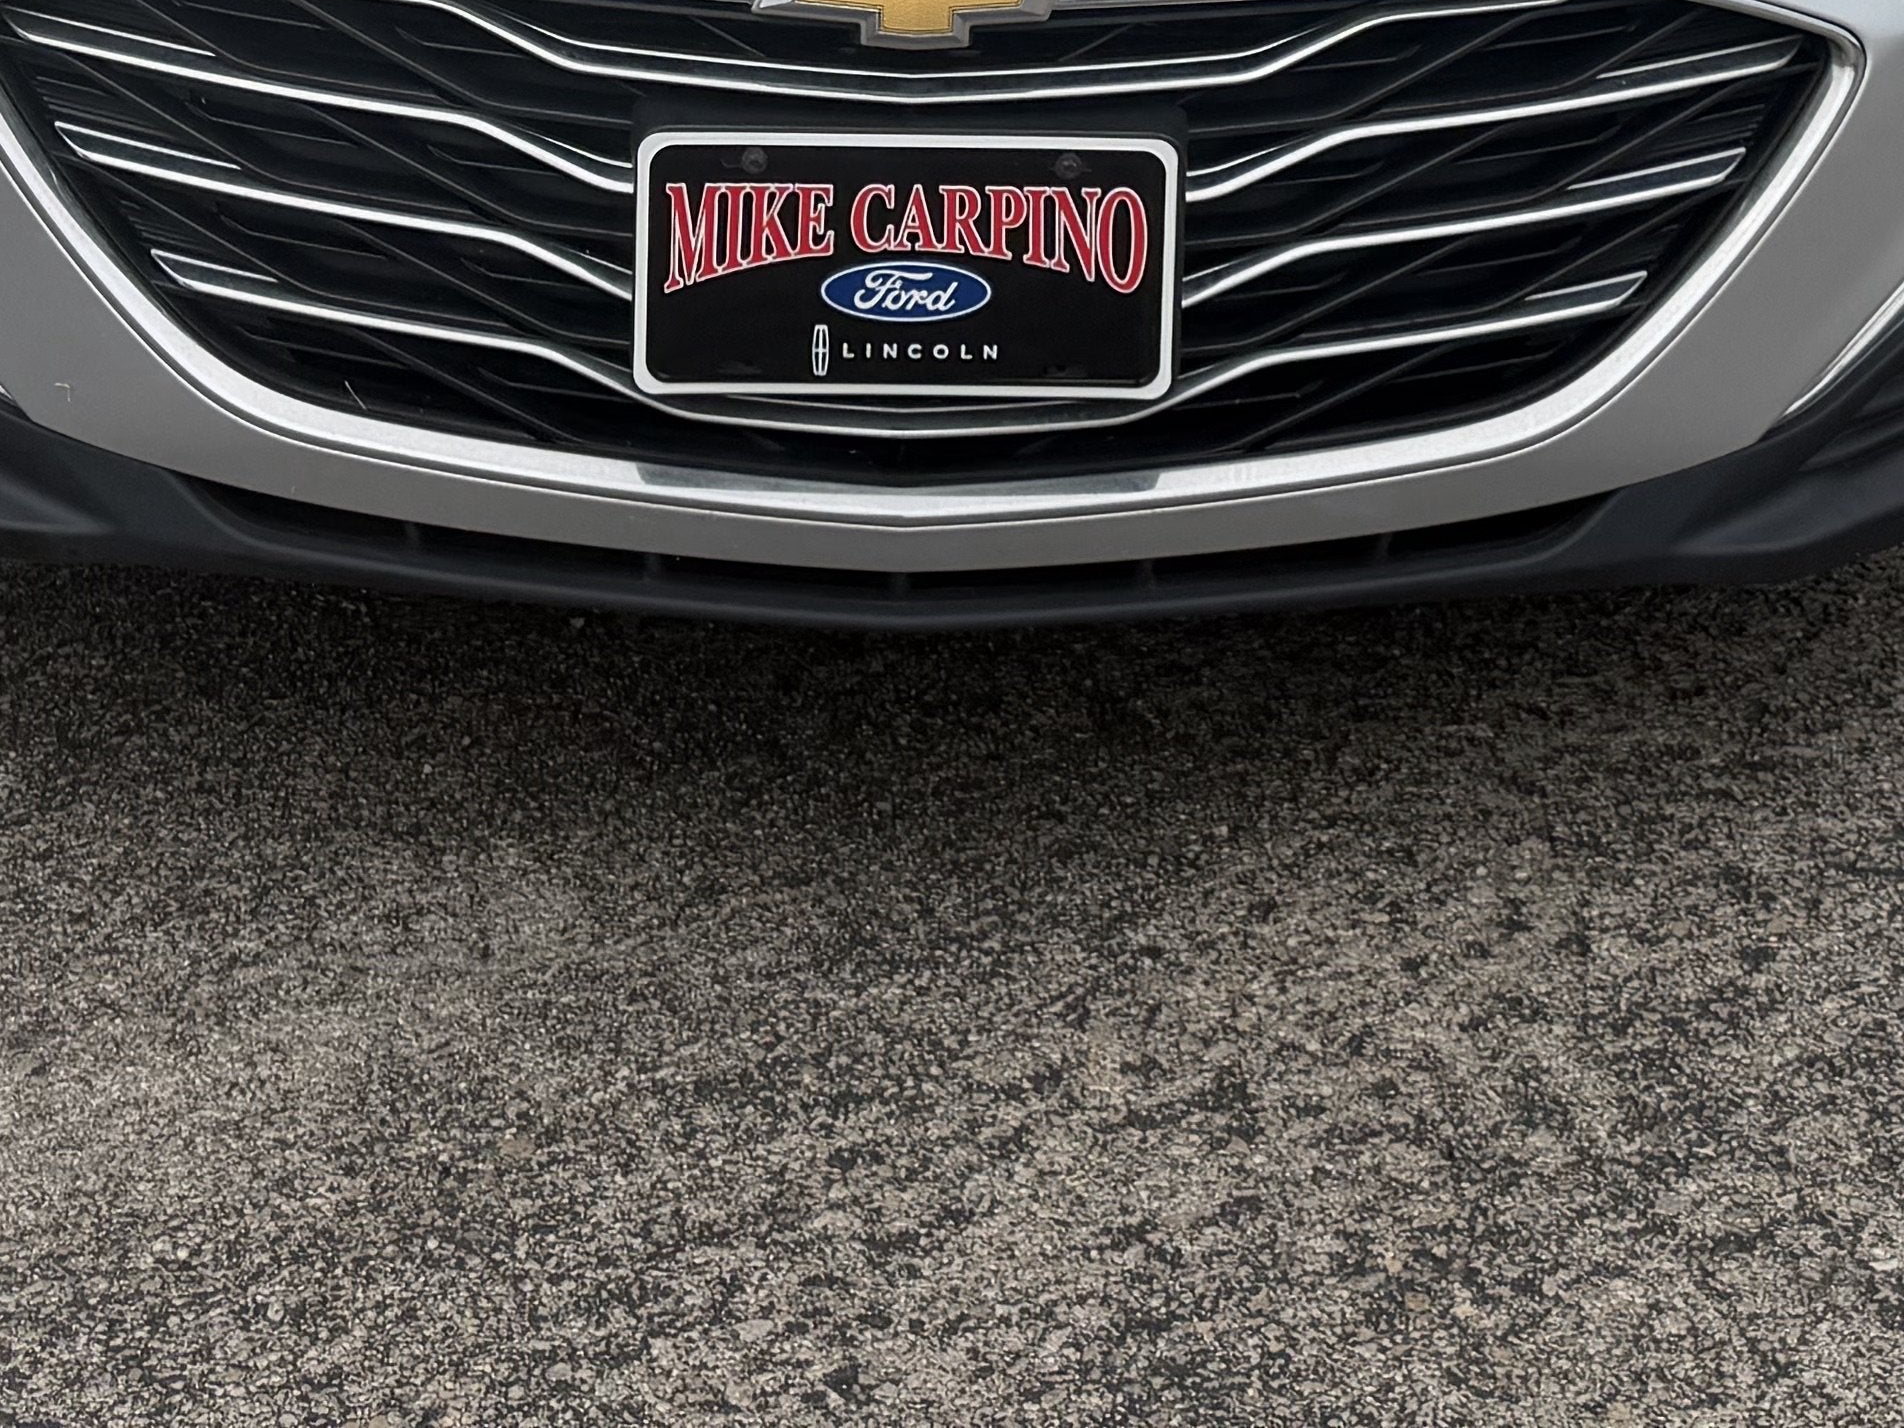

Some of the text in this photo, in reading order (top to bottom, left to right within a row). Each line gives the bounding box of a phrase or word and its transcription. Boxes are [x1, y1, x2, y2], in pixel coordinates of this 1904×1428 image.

[663, 182, 1148, 295] MIKE CARPINO
[853, 270, 955, 313] Ford
[842, 342, 998, 361] LINCOLN
